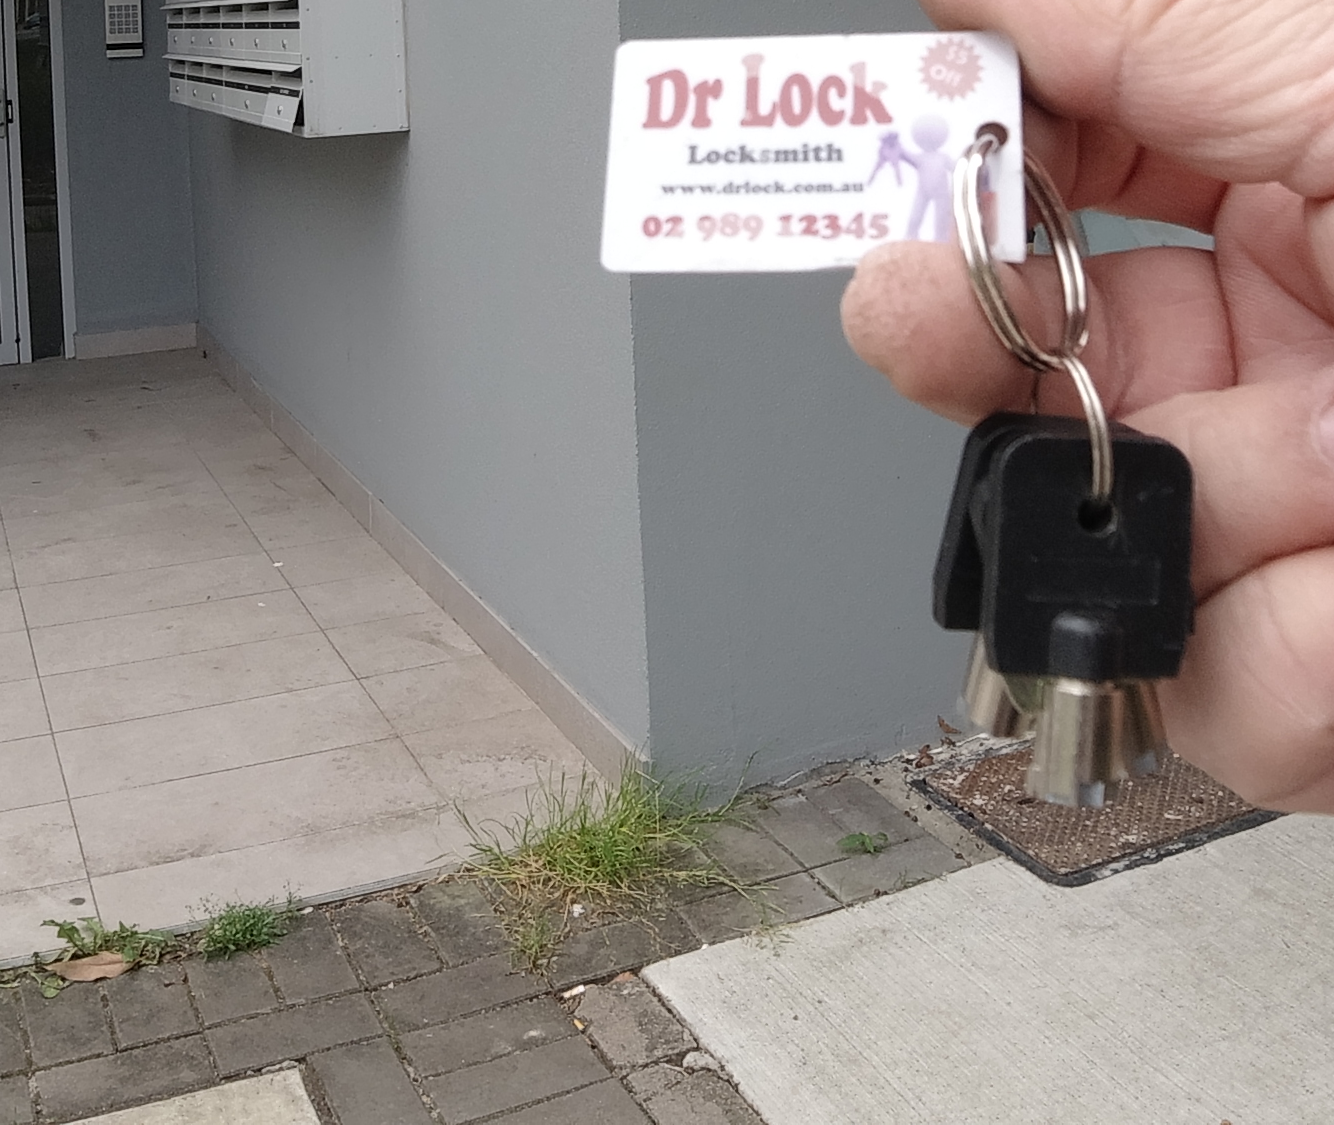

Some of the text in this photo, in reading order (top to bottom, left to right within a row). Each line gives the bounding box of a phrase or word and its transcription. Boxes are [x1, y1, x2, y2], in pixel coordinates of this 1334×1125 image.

[641, 53, 894, 130] Dr Lock
[687, 143, 845, 165] Locksmith
[660, 179, 866, 195] www.drlock.com.au
[641, 213, 891, 241] 02 989 12345
